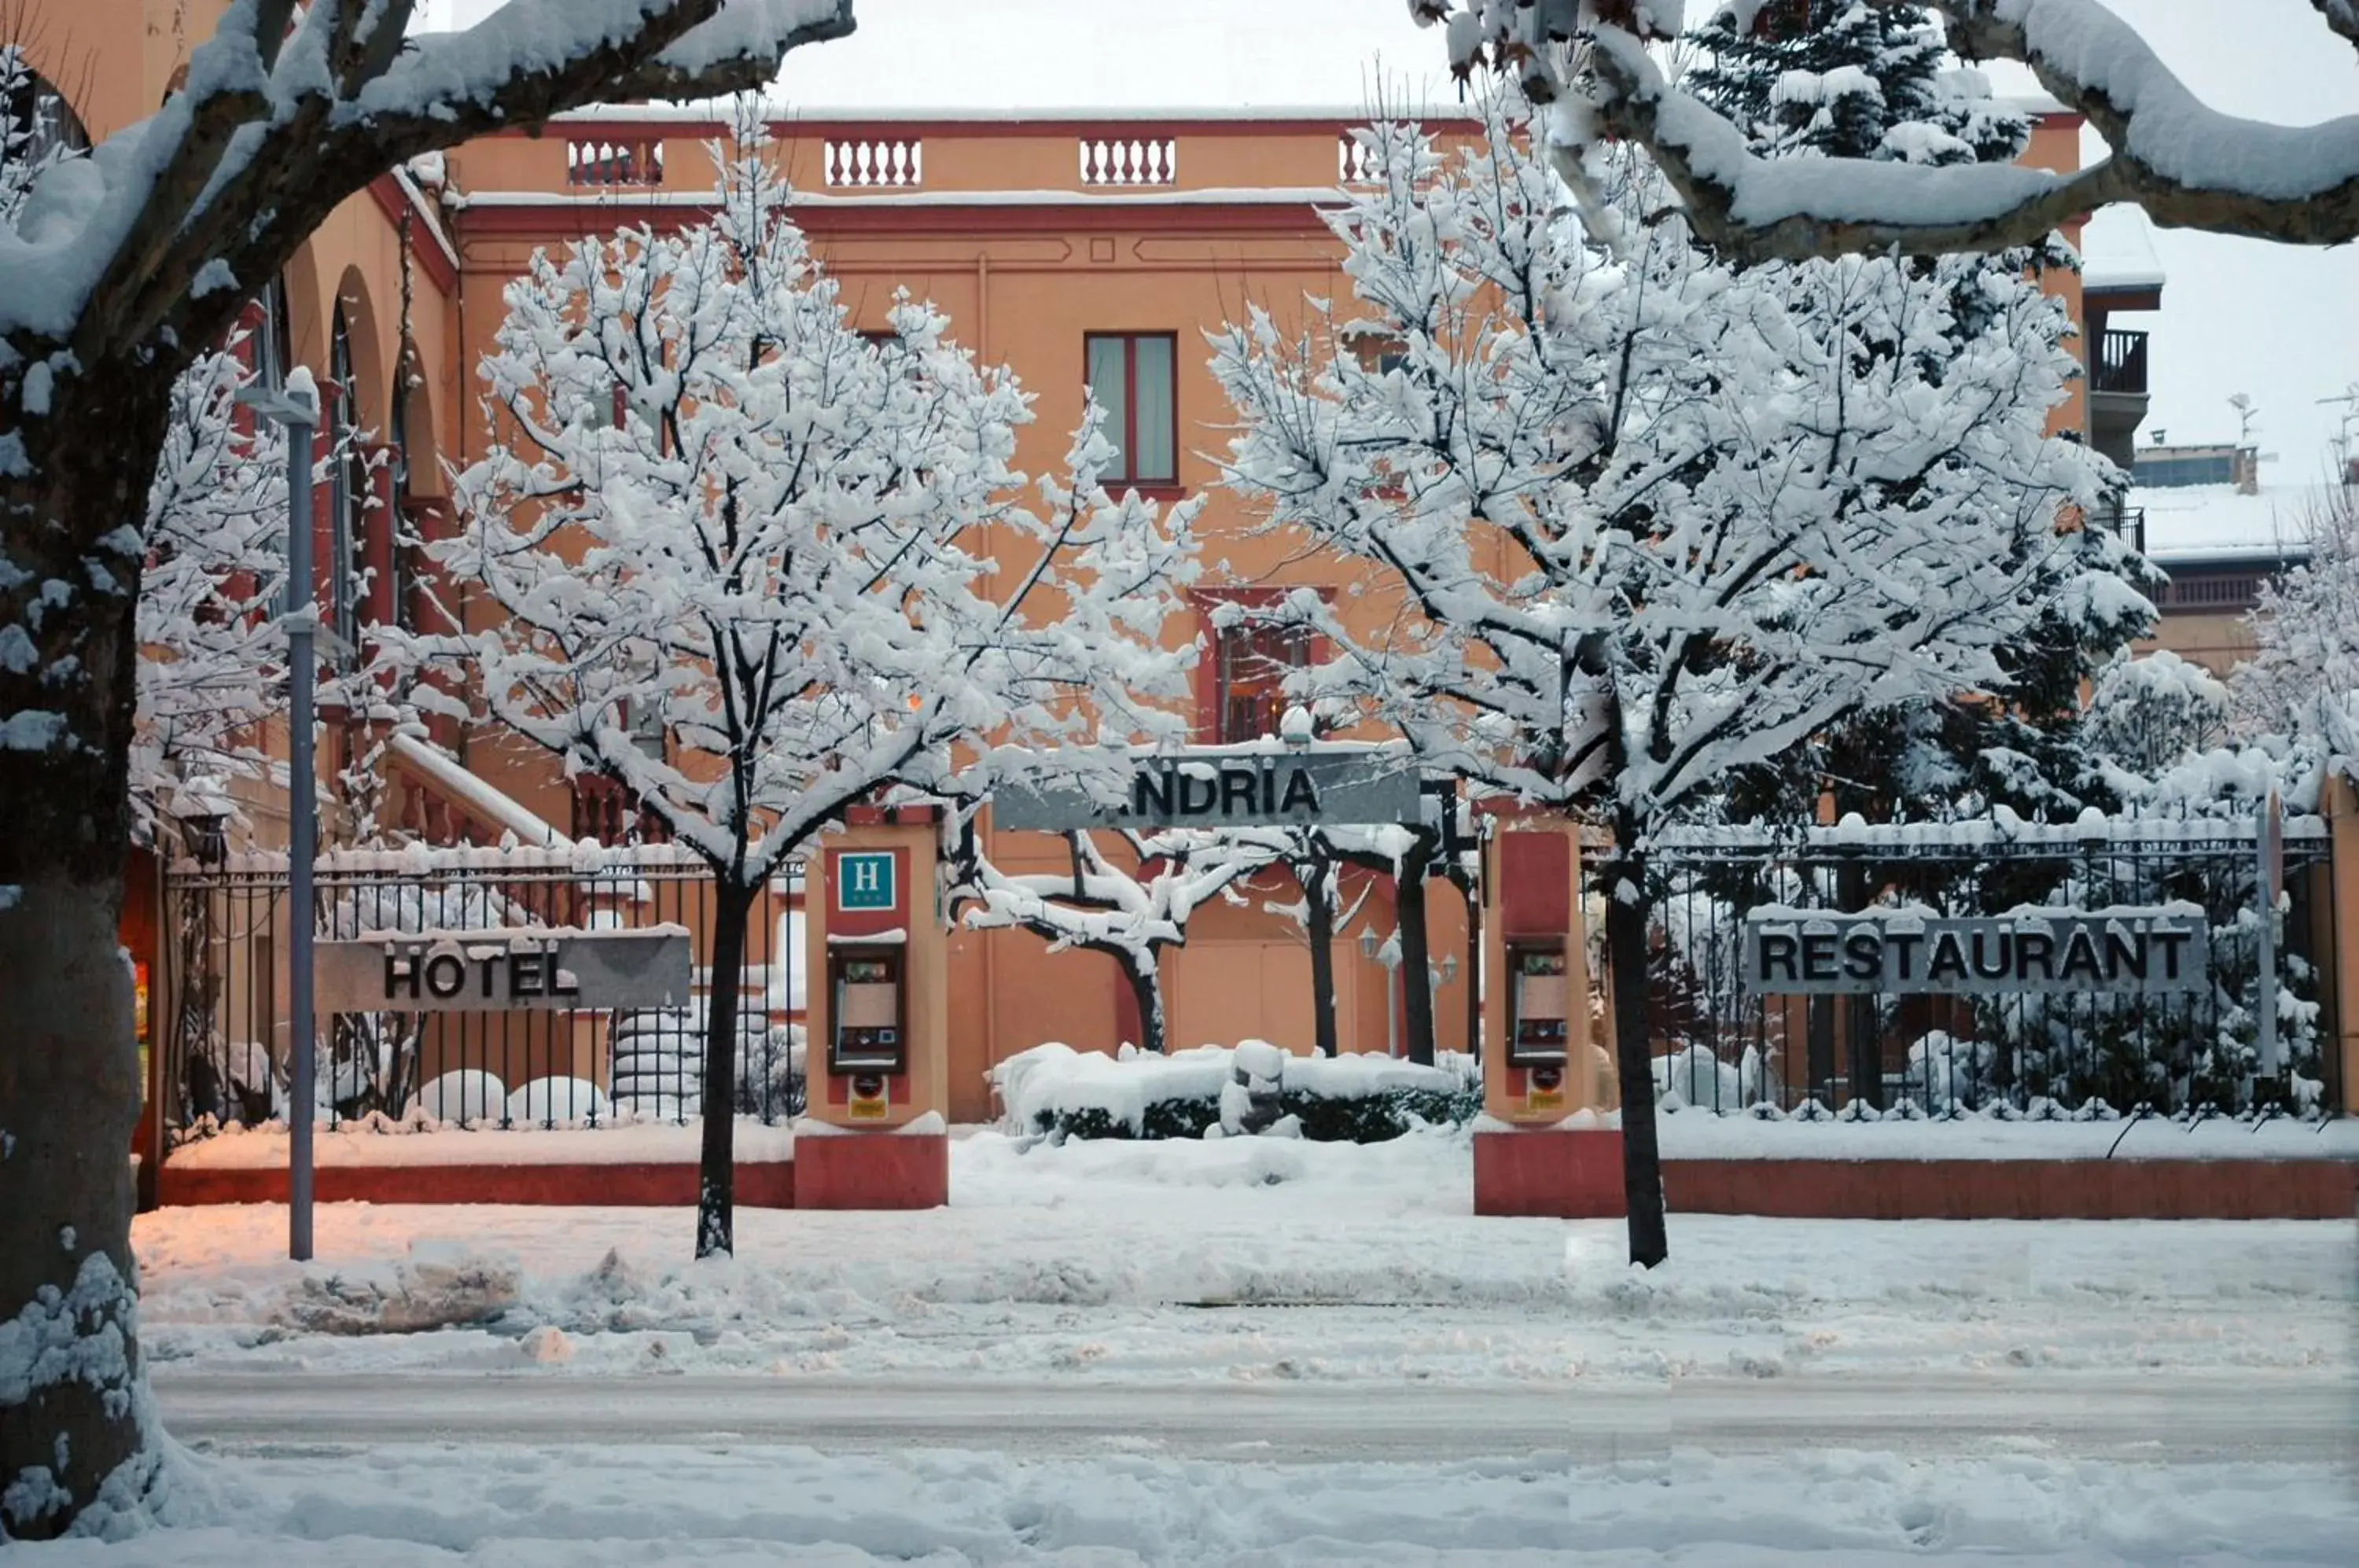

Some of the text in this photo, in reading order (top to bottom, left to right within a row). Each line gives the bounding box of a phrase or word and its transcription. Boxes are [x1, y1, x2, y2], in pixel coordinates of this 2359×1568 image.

[1093, 767, 1320, 815] NDRIA
[385, 952, 580, 999] HOTEL
[1760, 932, 2192, 981] RESTAURANT
